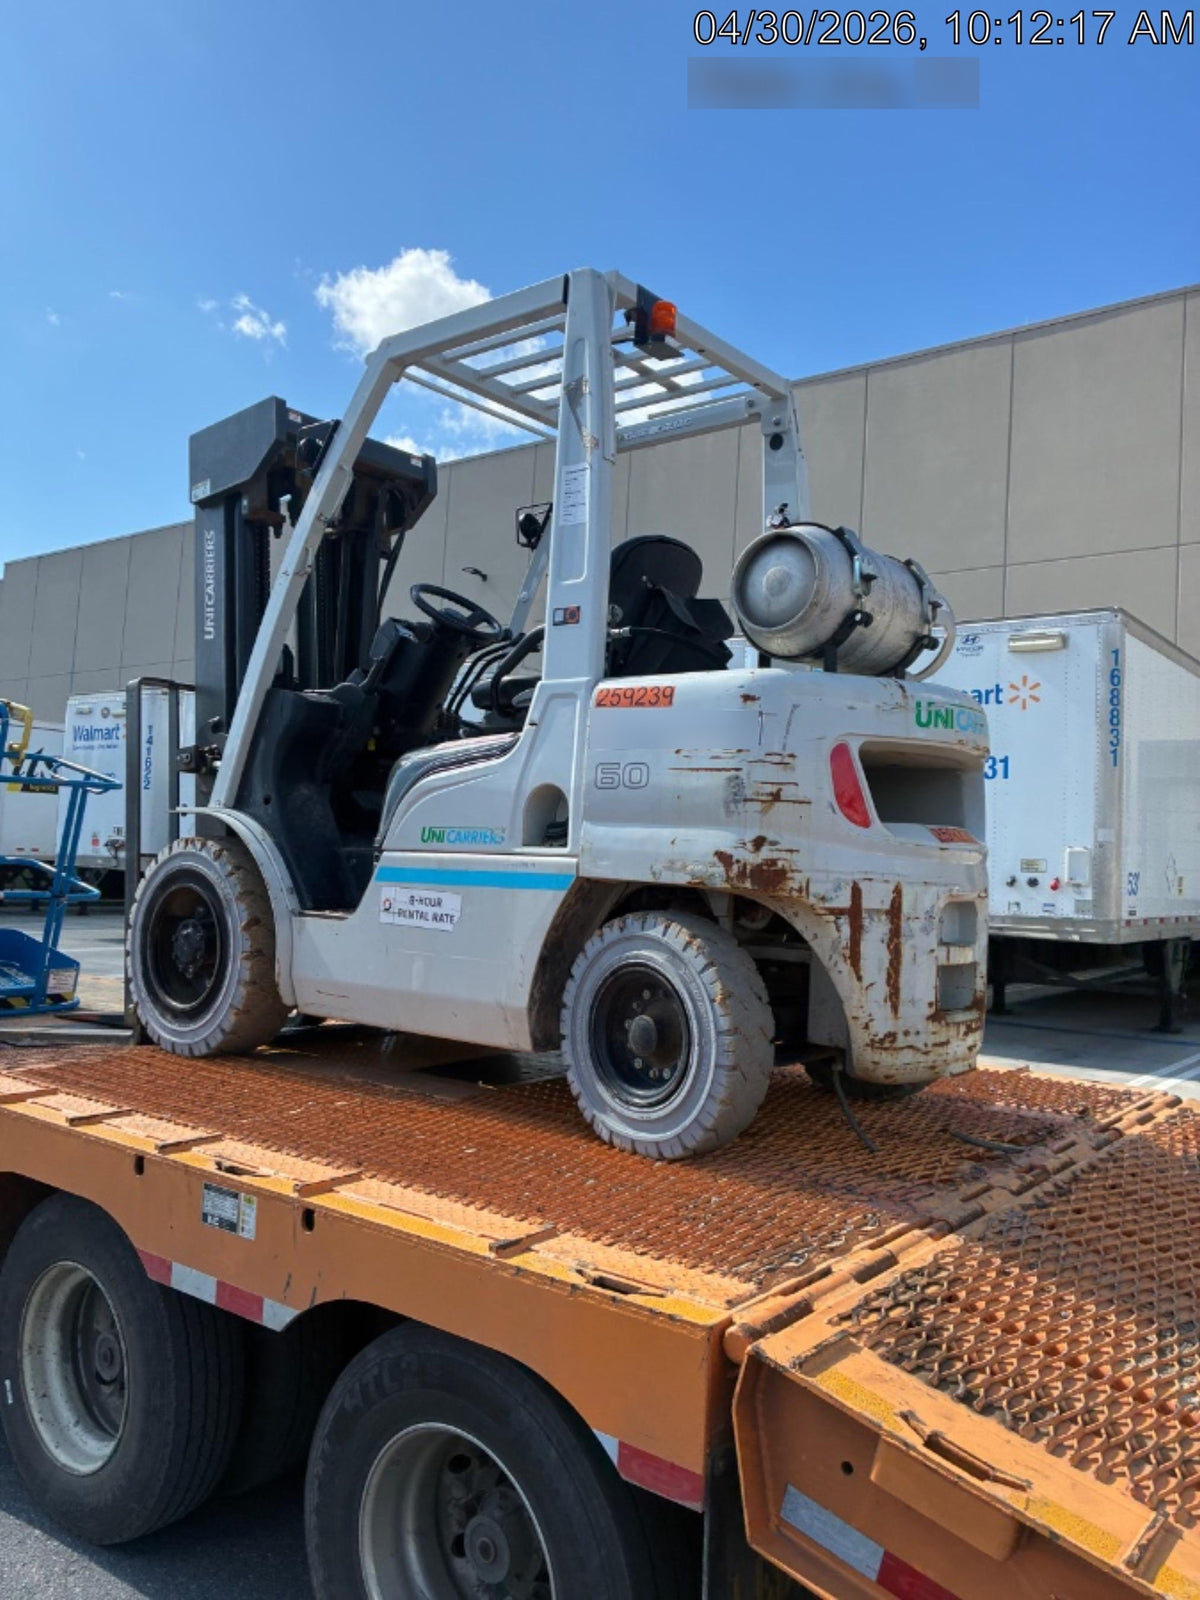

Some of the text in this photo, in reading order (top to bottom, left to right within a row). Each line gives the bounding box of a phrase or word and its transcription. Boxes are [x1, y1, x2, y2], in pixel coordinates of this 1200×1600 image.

[204, 530, 216, 640] UNICARRIERS
[596, 686, 674, 707] 259239
[961, 684, 1003, 704] art
[1109, 648, 1121, 767] 168831
[73, 723, 120, 741] Walmart
[595, 762, 650, 790] 60
[984, 755, 1009, 779] 31
[431, 911, 456, 924] RATE
